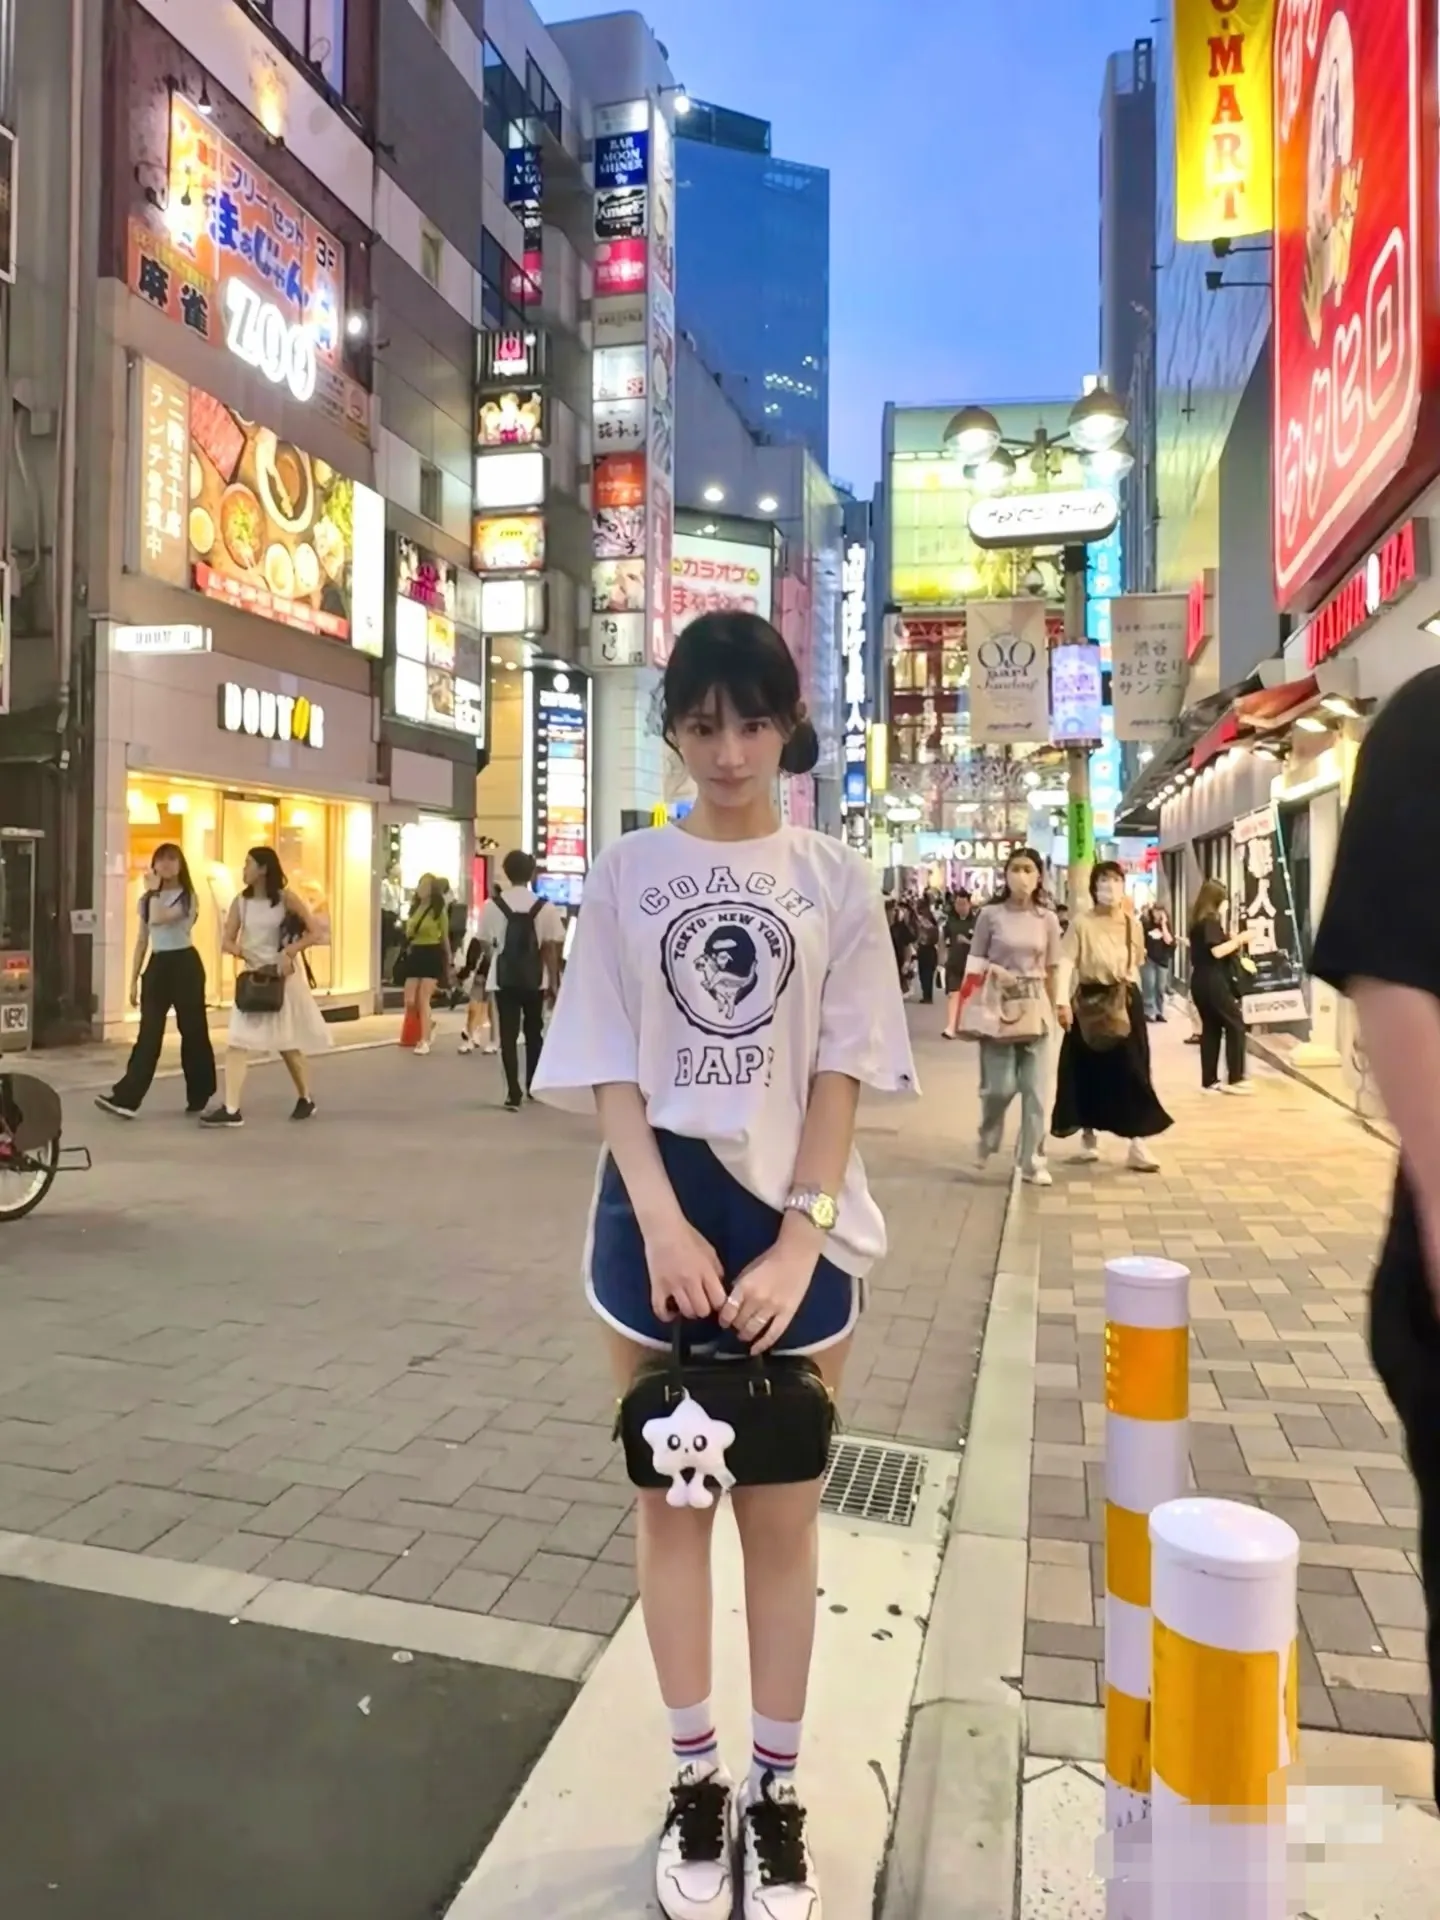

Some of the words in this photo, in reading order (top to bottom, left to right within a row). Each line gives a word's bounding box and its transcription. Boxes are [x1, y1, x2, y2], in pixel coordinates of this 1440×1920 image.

[610, 136, 635, 150] BAR
[602, 147, 641, 163] MOON
[138, 254, 209, 337] 麻雀
[683, 559, 747, 583] カラオケ
[1119, 659, 1183, 677] おとなり
[1119, 679, 1182, 696] サンデー
[639, 866, 815, 918] COACH
[673, 917, 708, 961] TOKYO
[756, 920, 781, 959] YORK
